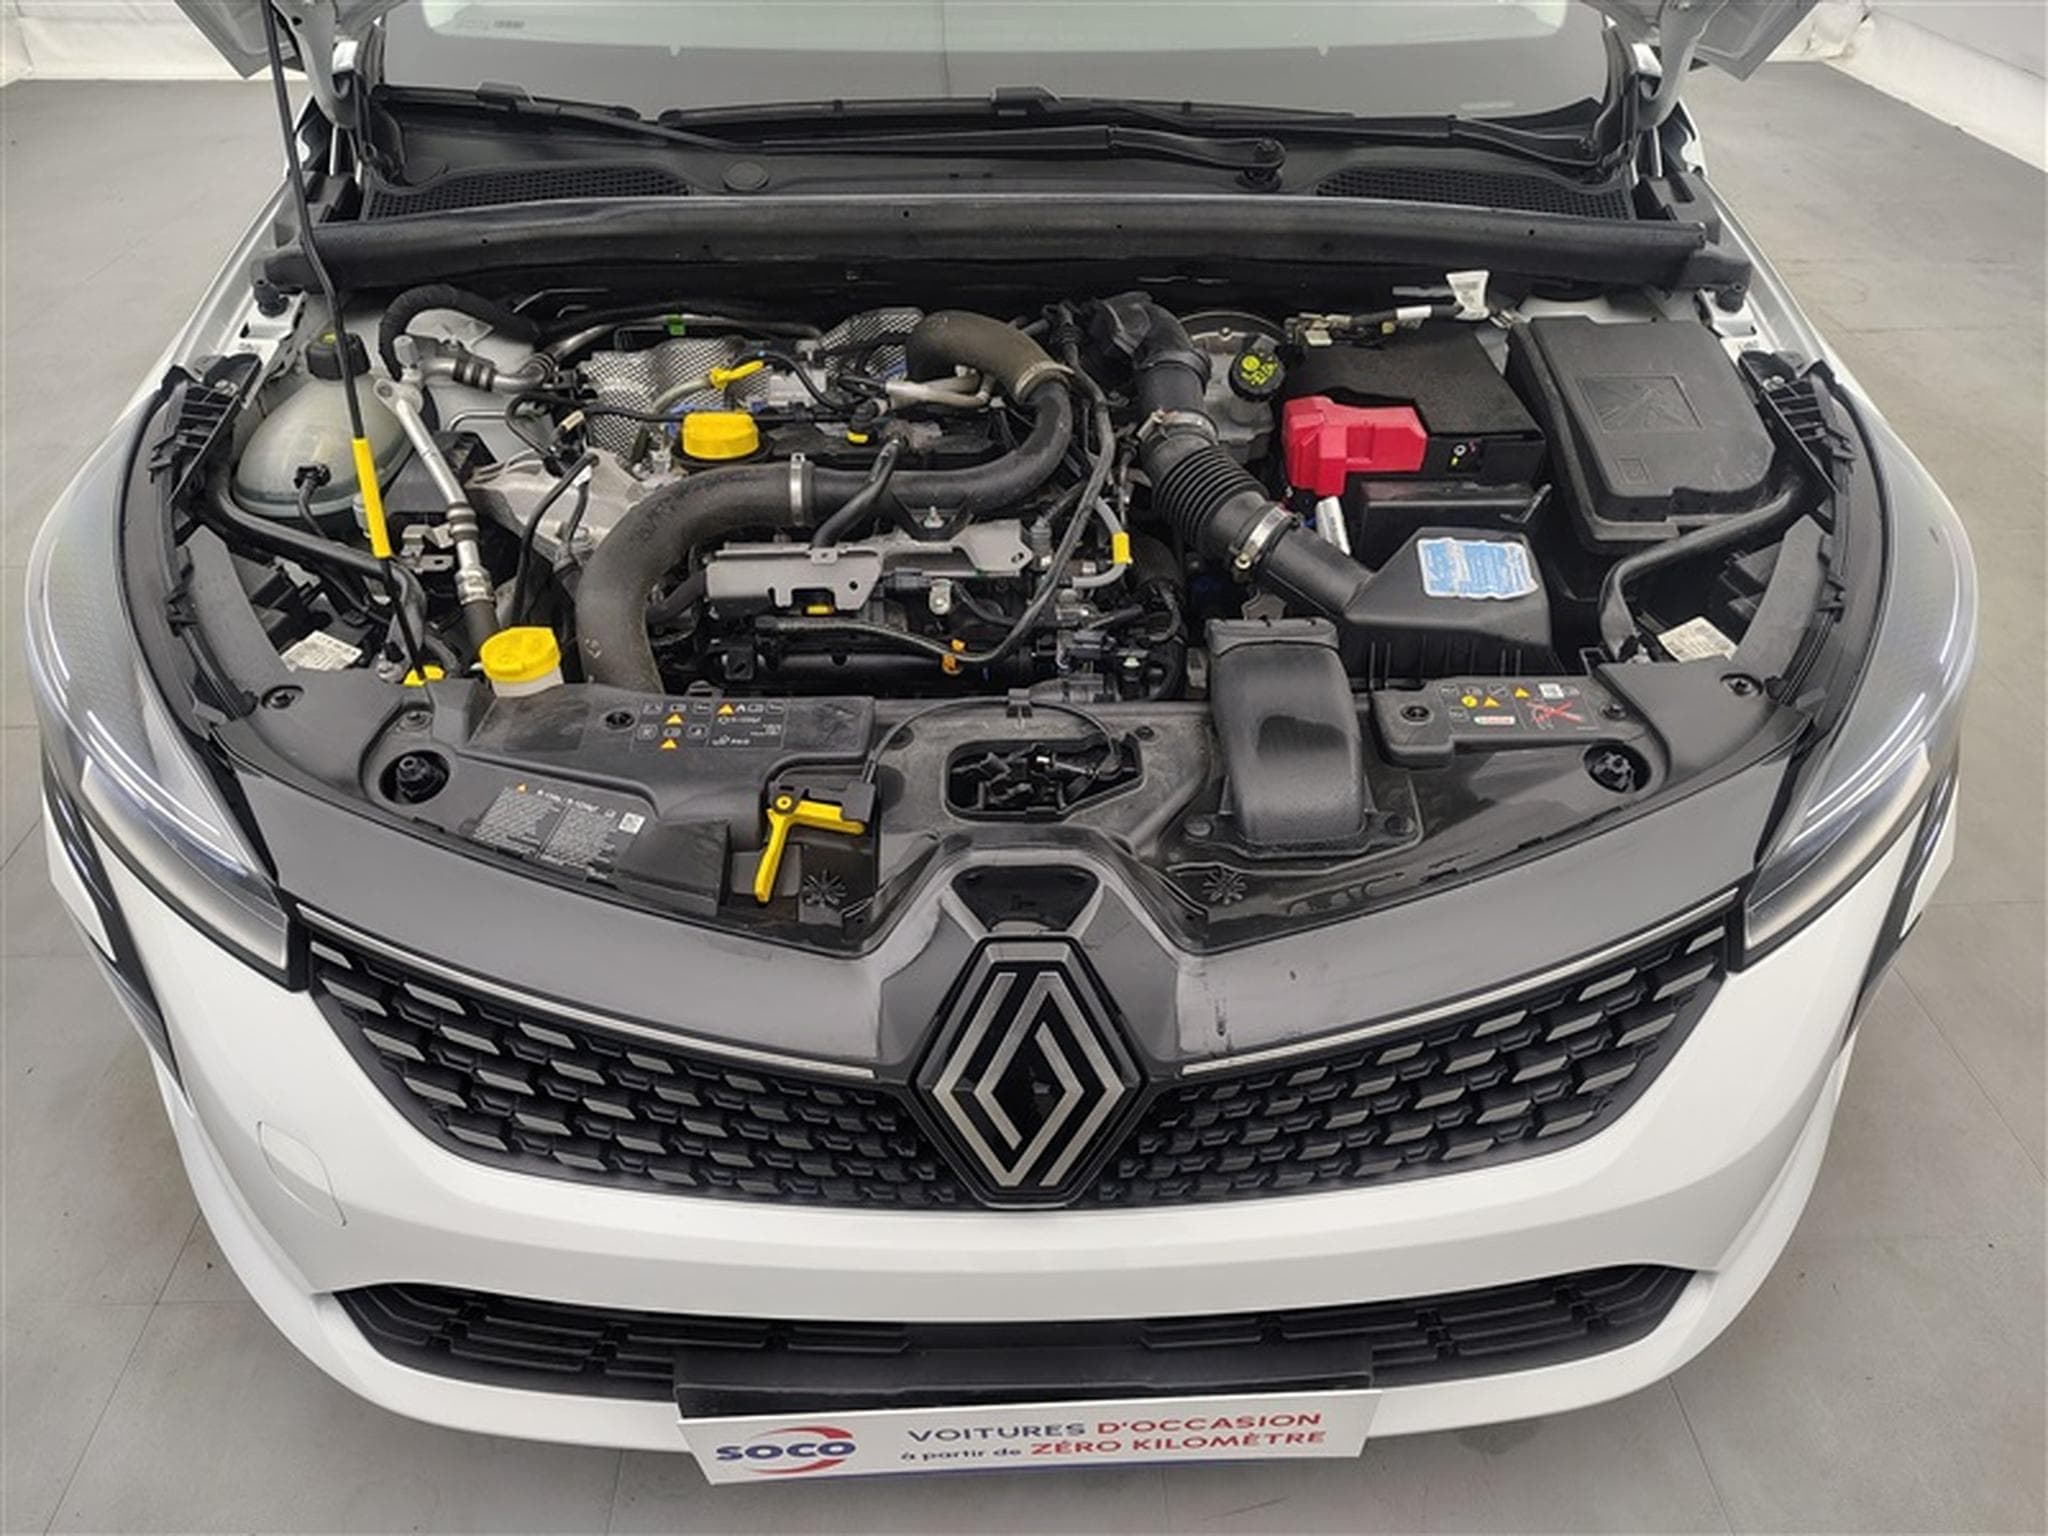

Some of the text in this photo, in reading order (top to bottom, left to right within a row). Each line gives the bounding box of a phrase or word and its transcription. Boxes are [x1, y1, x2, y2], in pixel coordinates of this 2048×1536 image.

[907, 1413, 1322, 1442] VOITURES D'OCCASION
[716, 1441, 856, 1461] SOCO
[900, 1430, 1326, 1461] à partir de ZÉRO KILOMÈTRE
